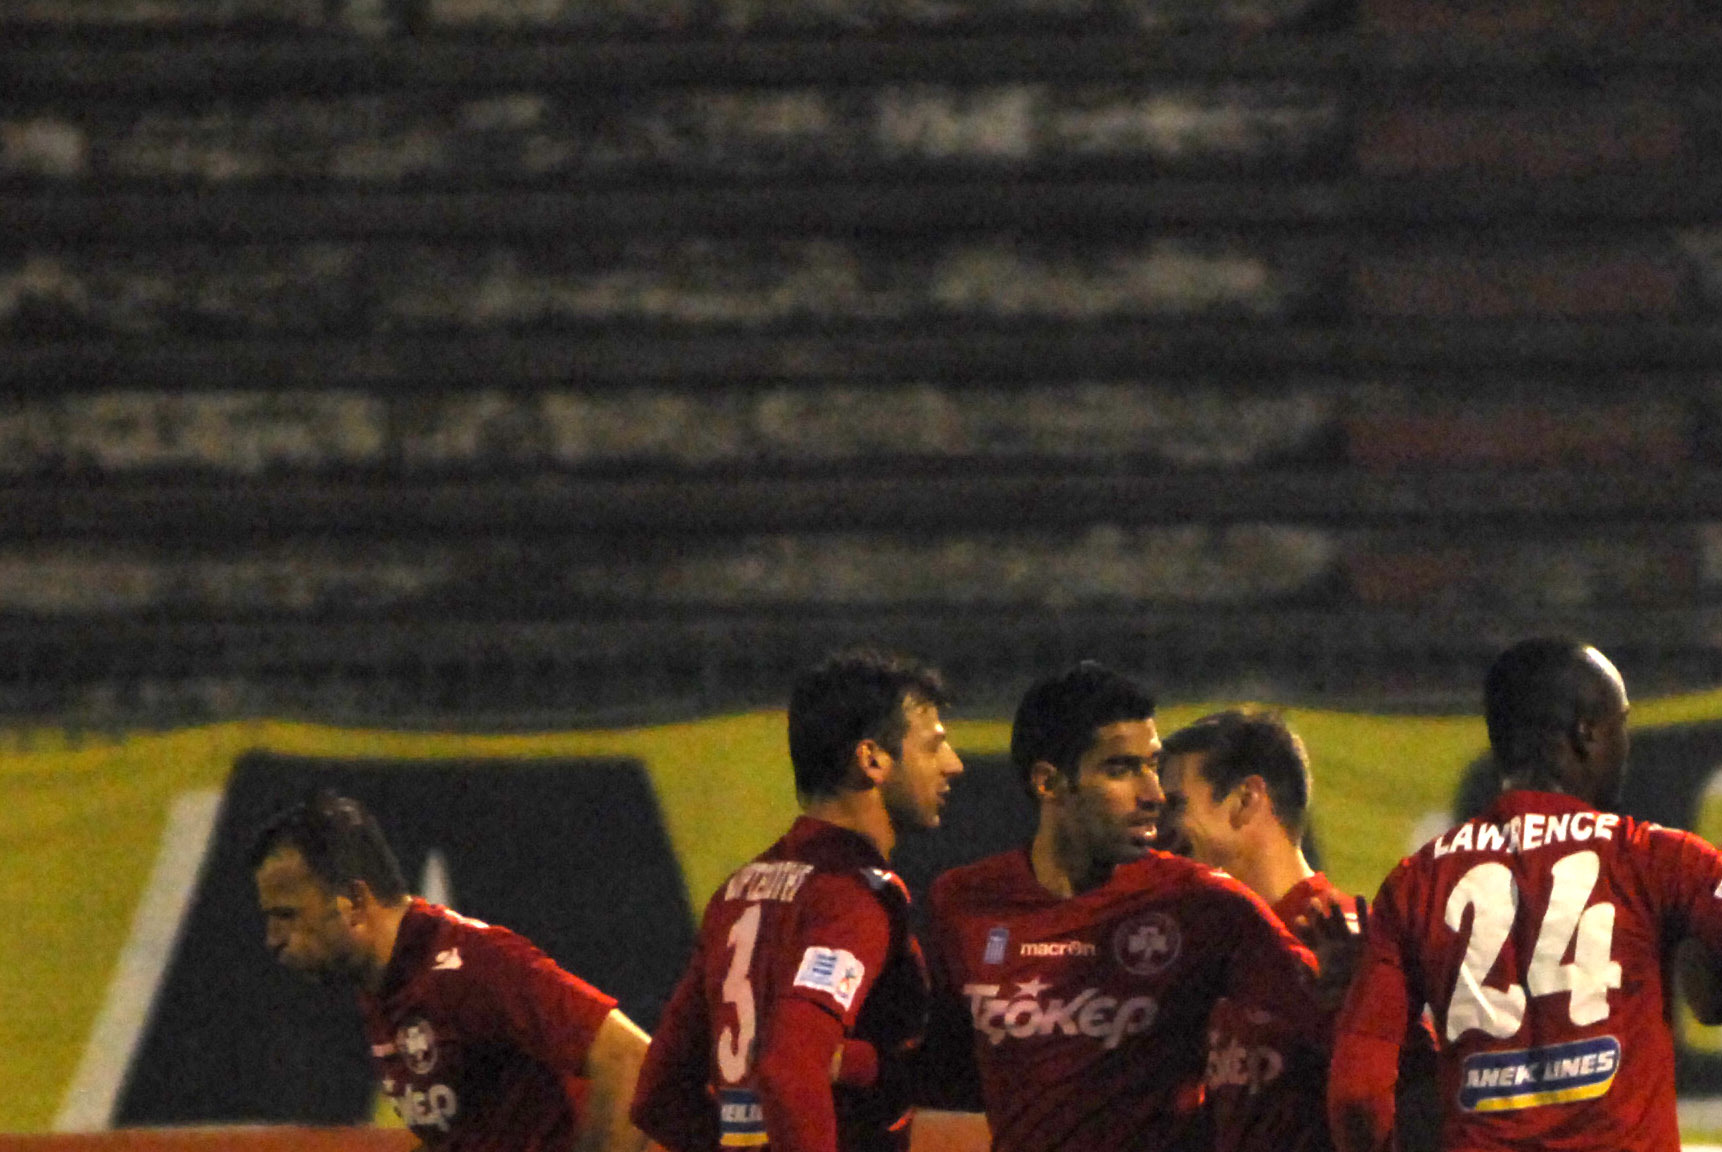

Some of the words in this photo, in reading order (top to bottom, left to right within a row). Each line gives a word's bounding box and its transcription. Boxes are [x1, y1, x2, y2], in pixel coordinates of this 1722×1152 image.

[1434, 811, 1620, 858] LAWRENCE
[1020, 941, 1096, 957] macron
[1445, 850, 1622, 1042] 24
[1465, 1064, 1536, 1088] ANEK
[1543, 1050, 1616, 1082] LINES
